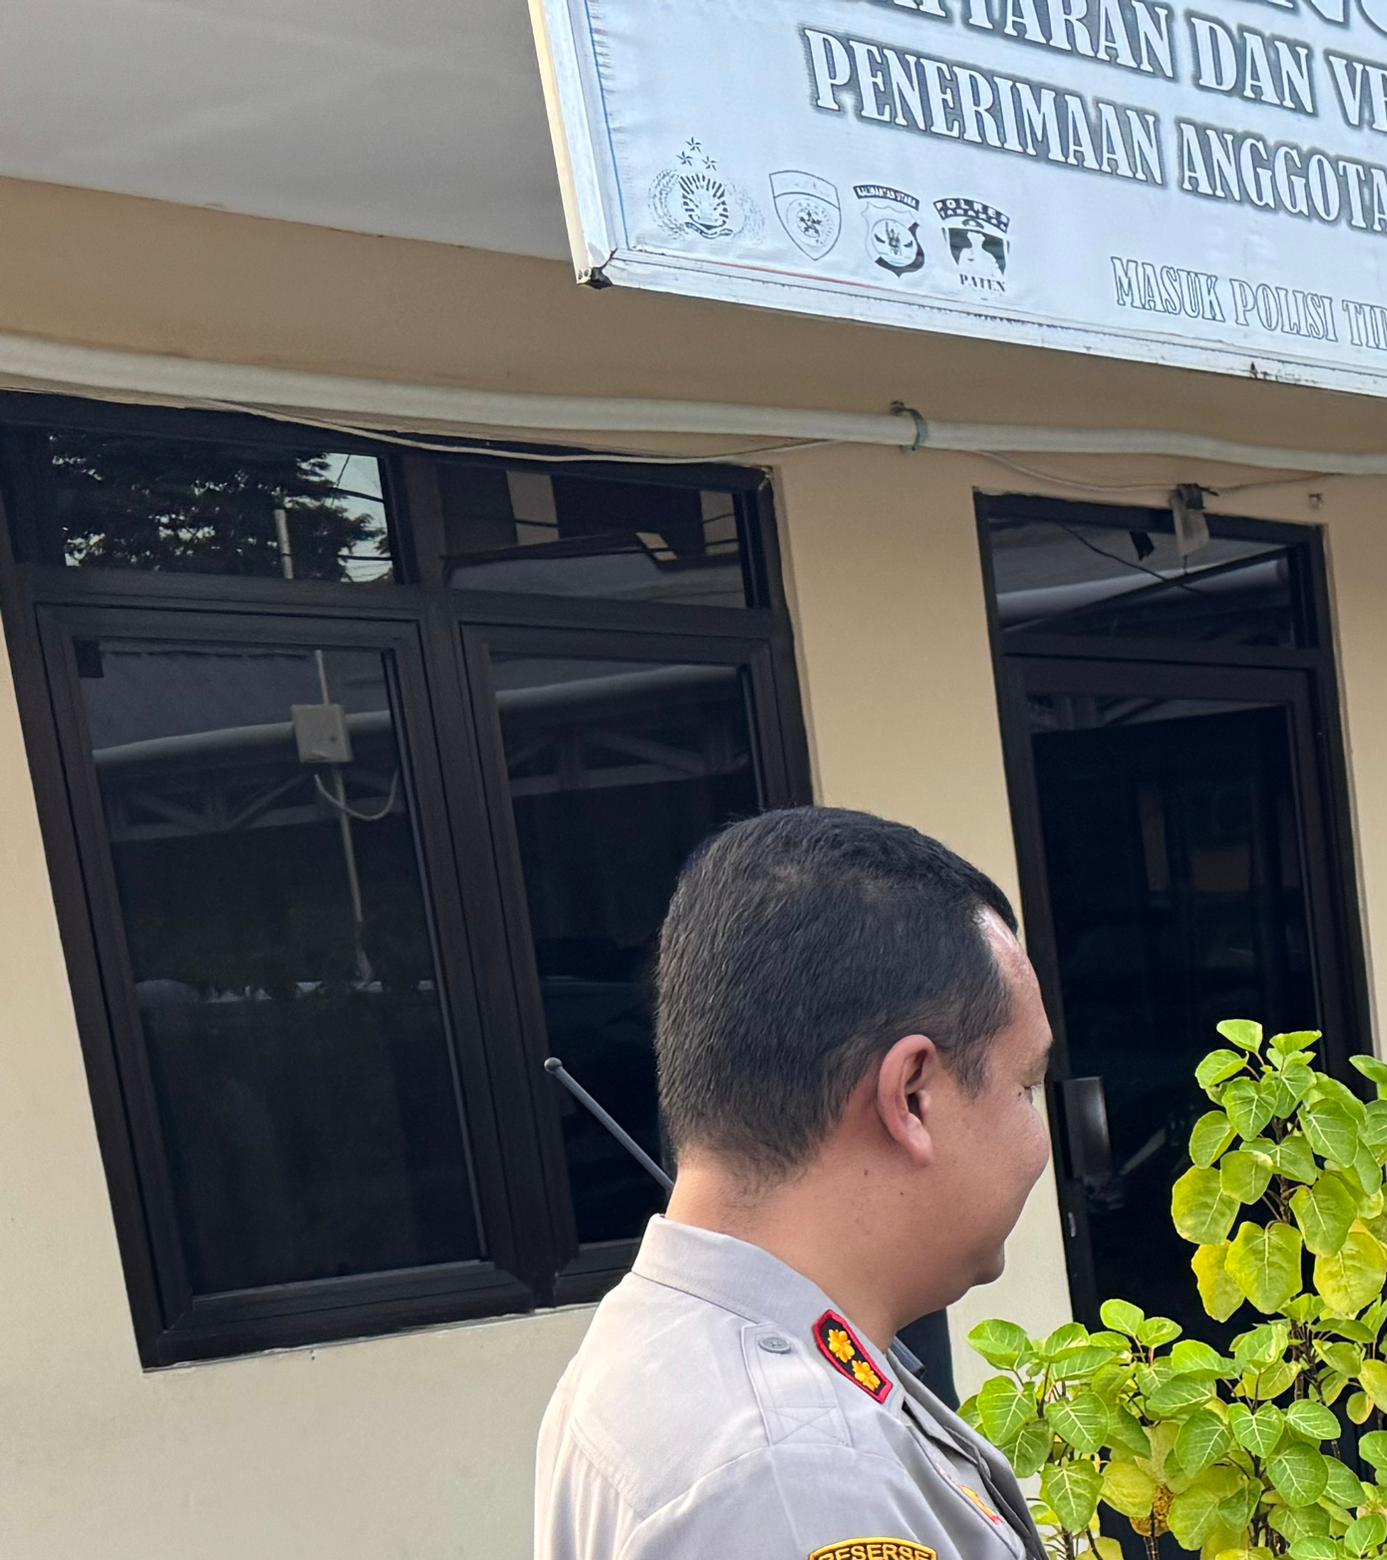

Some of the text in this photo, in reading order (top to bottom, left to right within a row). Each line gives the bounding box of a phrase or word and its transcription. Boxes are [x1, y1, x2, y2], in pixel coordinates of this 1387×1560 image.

[803, 28, 1164, 186] PENERIMAAN
[1190, 17, 1316, 115] DAN
[1110, 256, 1226, 323] MASUK
[1230, 279, 1338, 343] POLISI
